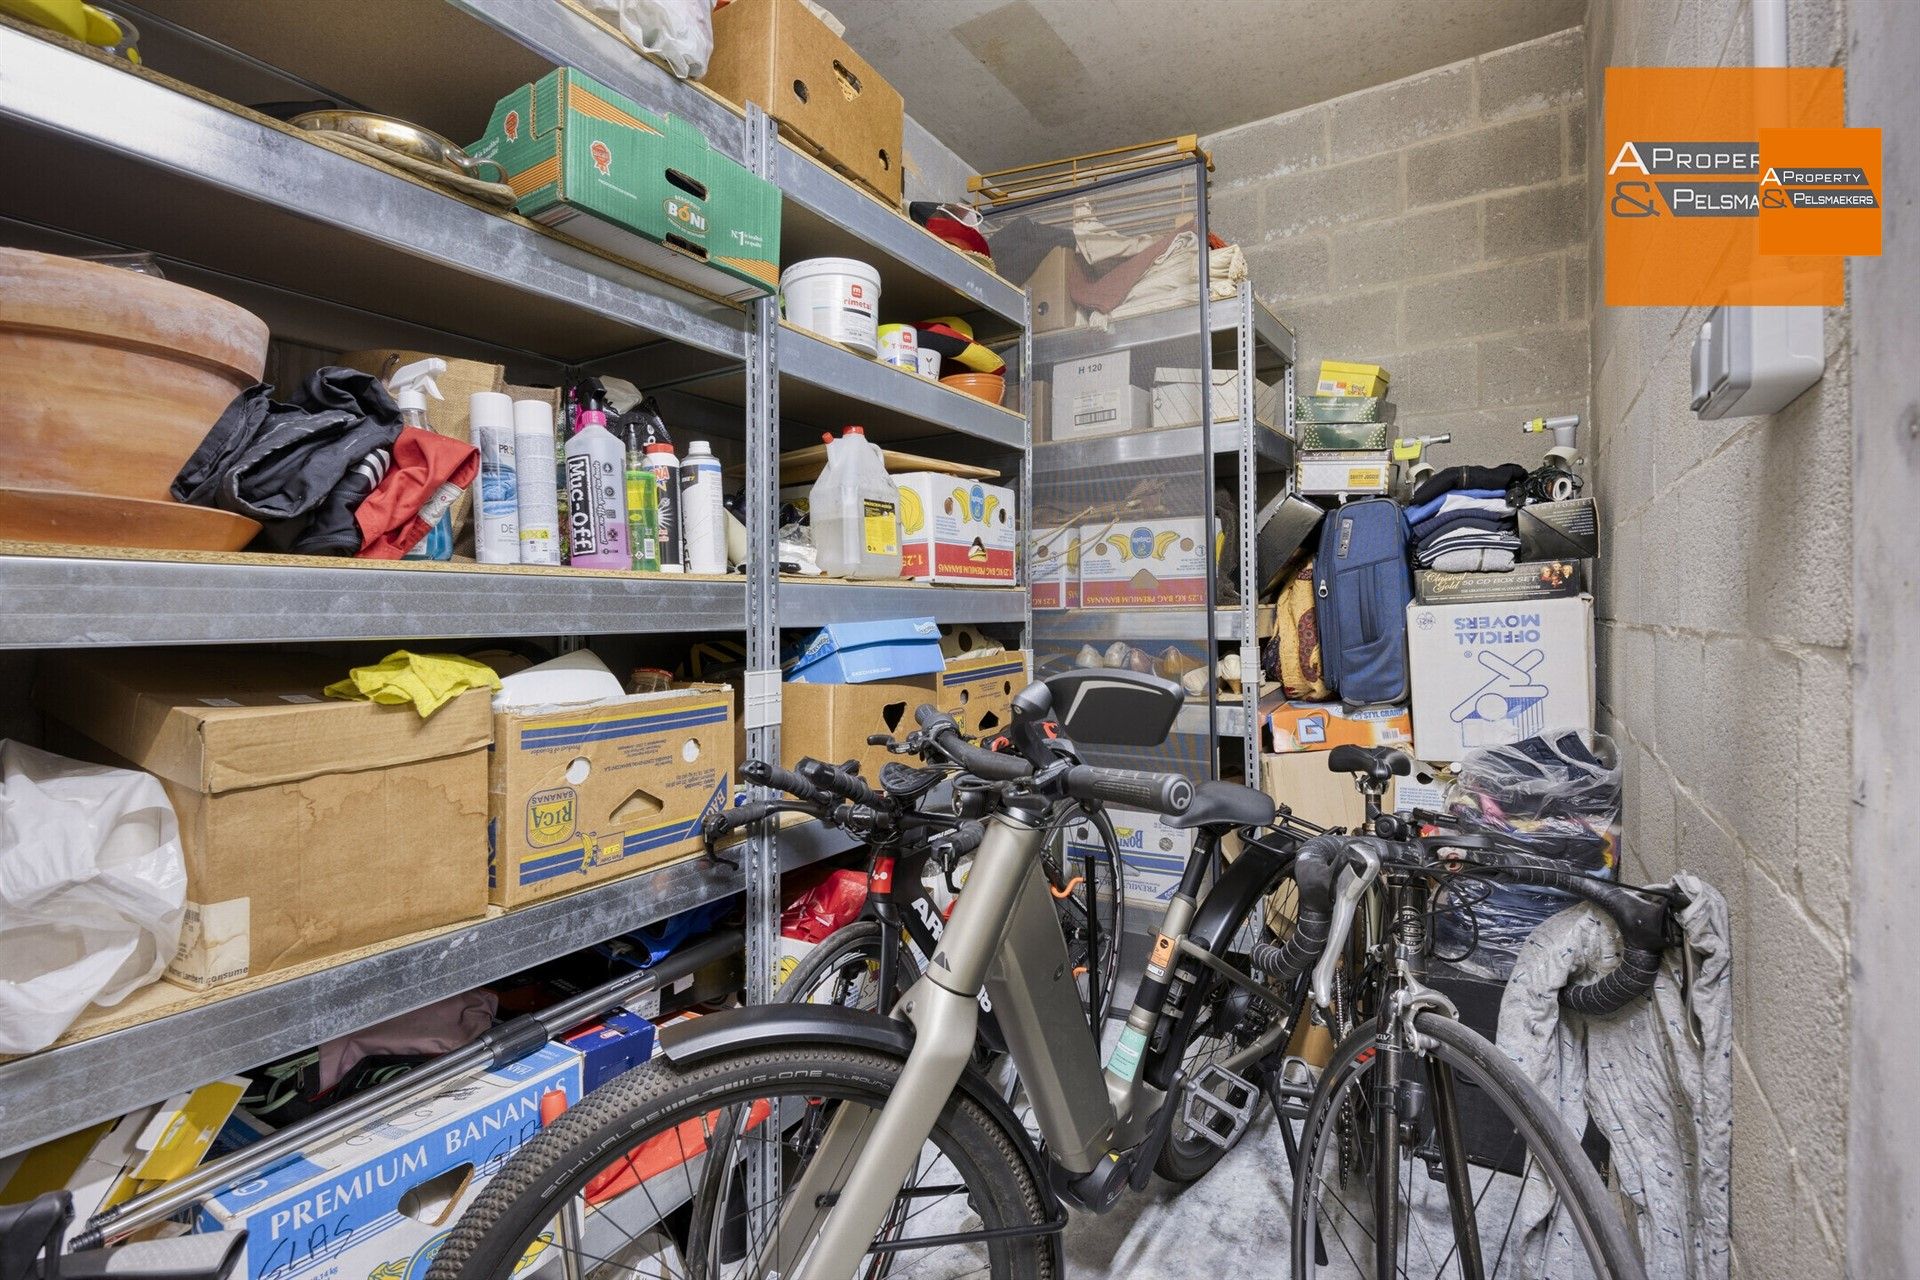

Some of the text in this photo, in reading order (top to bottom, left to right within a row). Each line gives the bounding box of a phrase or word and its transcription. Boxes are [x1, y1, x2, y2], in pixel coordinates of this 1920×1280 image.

[668, 202, 705, 230] BONI
[1078, 363, 1103, 375] H 120
[569, 460, 593, 549] Muc-Off
[1086, 595, 1120, 604] BANANAS
[1122, 595, 1156, 603] PREMIUM
[1157, 594, 1174, 603] BAG
[1175, 594, 1187, 602] KG
[1454, 613, 1541, 630] MOVERS
[1454, 629, 1541, 645] OFFICIAL
[531, 790, 574, 805] BANANAS
[530, 800, 573, 829] RICA
[1124, 882, 1158, 893] PREMIU
[752, 1070, 823, 1083] G-ONE
[826, 1072, 891, 1090] ALLROUND
[484, 1118, 544, 1178] GLA
[541, 1110, 661, 1199] SCHWALBE
[270, 1144, 428, 1241] PREMIUM
